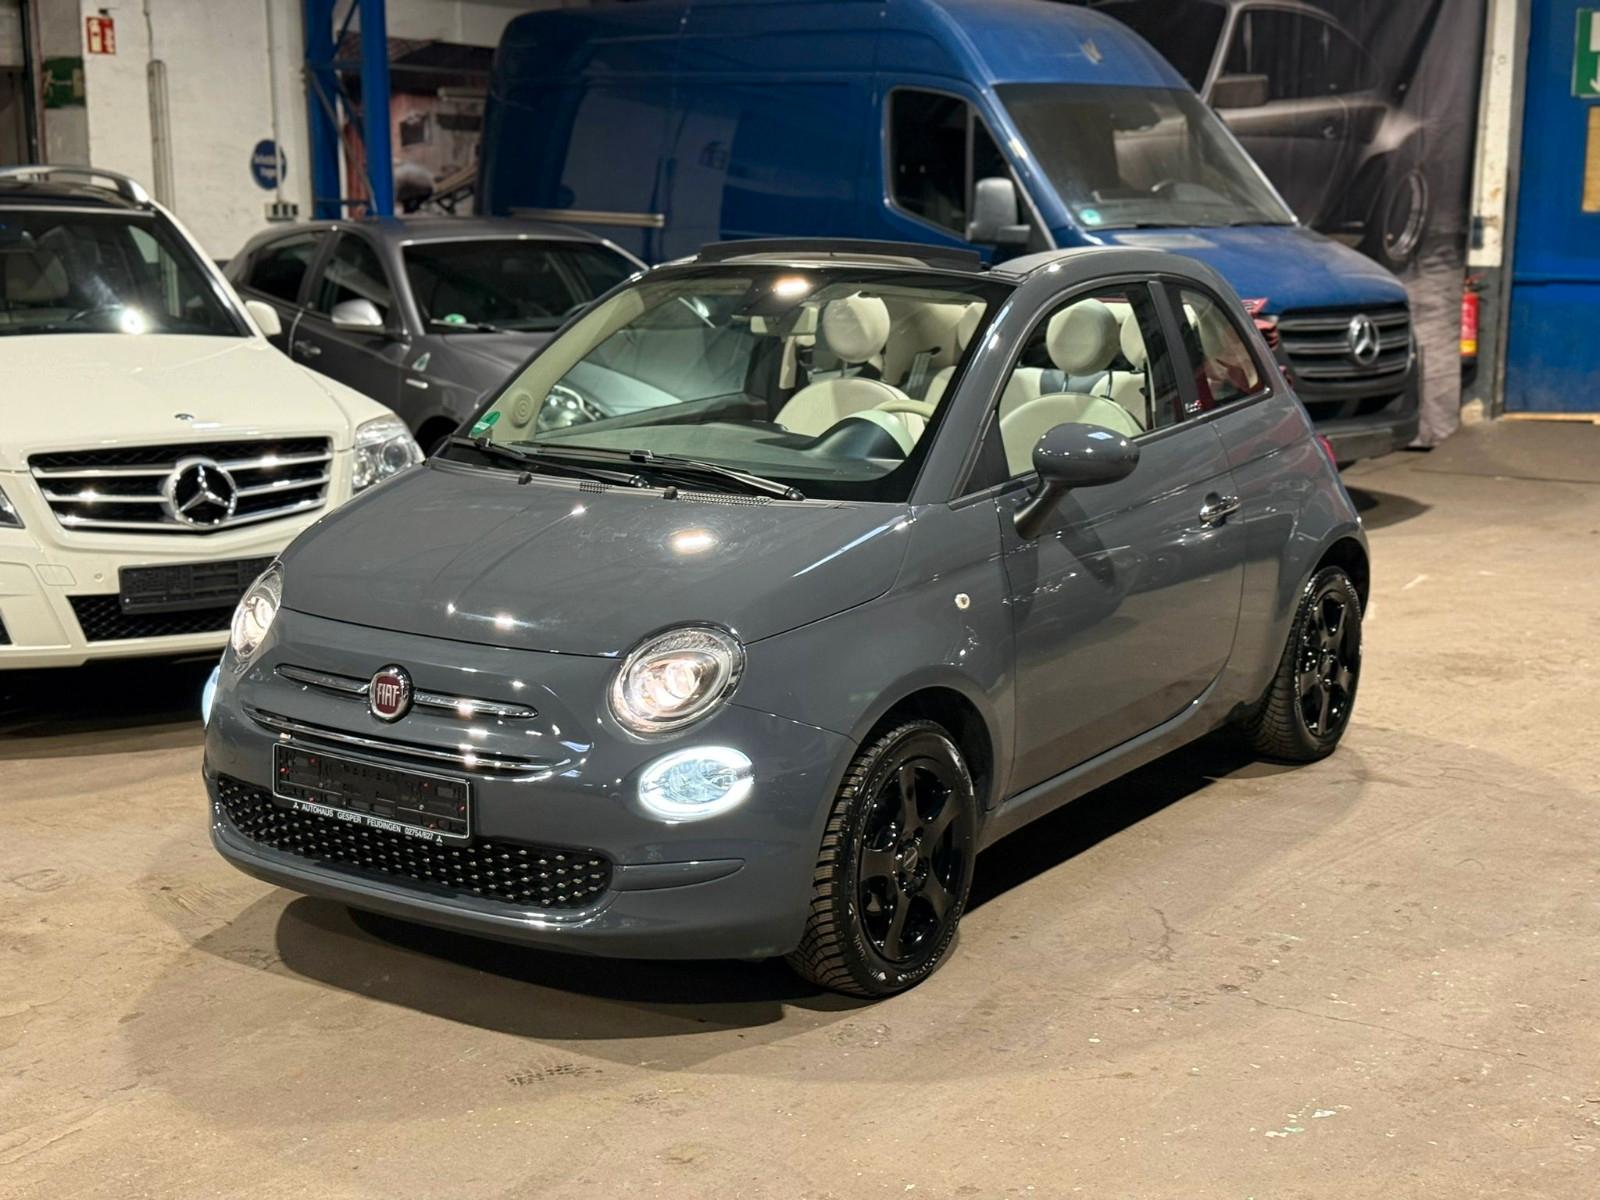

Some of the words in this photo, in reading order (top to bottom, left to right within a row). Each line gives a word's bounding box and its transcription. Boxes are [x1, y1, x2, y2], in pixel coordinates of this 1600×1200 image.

[376, 683, 400, 707] FIAT
[301, 803, 334, 818] AUTOHAUS
[337, 811, 362, 824] GESPER
[367, 818, 401, 833] FEUDINGEN
